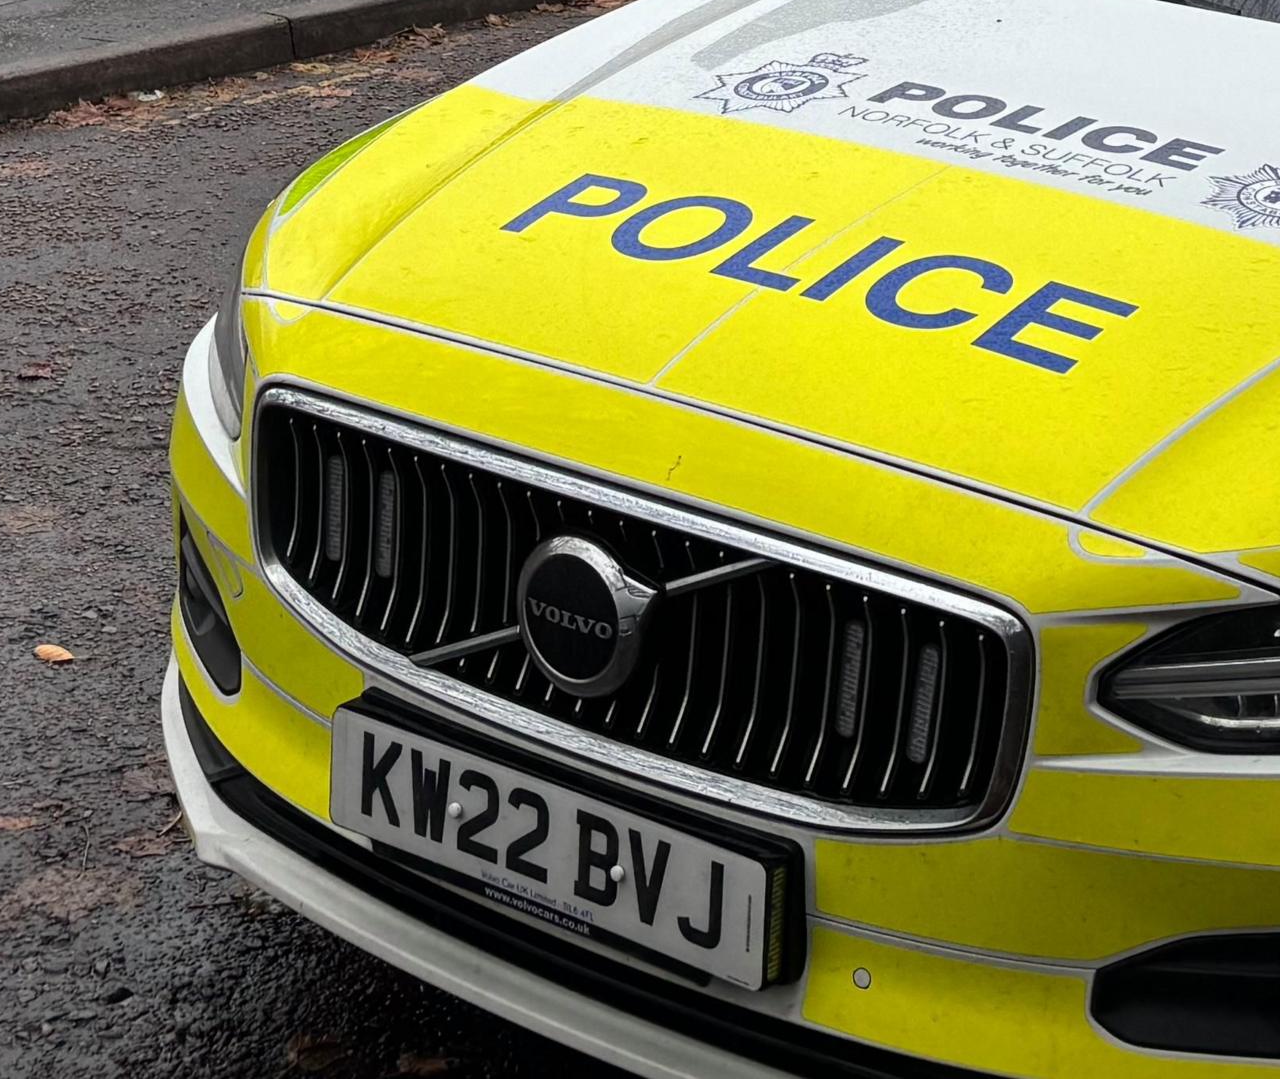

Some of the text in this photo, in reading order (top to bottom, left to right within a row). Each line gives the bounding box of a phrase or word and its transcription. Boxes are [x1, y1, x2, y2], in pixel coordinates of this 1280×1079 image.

[837, 105, 1177, 188] NORFOLK & SUFFOLK
[867, 81, 1226, 173] POLICE
[915, 137, 1154, 197] working together for you
[499, 172, 1141, 375] POLICE
[528, 596, 613, 640] VOLVO
[361, 731, 549, 886] KW22
[574, 808, 725, 950] BVJ
[483, 886, 591, 936] www.volvocars.co.uk
